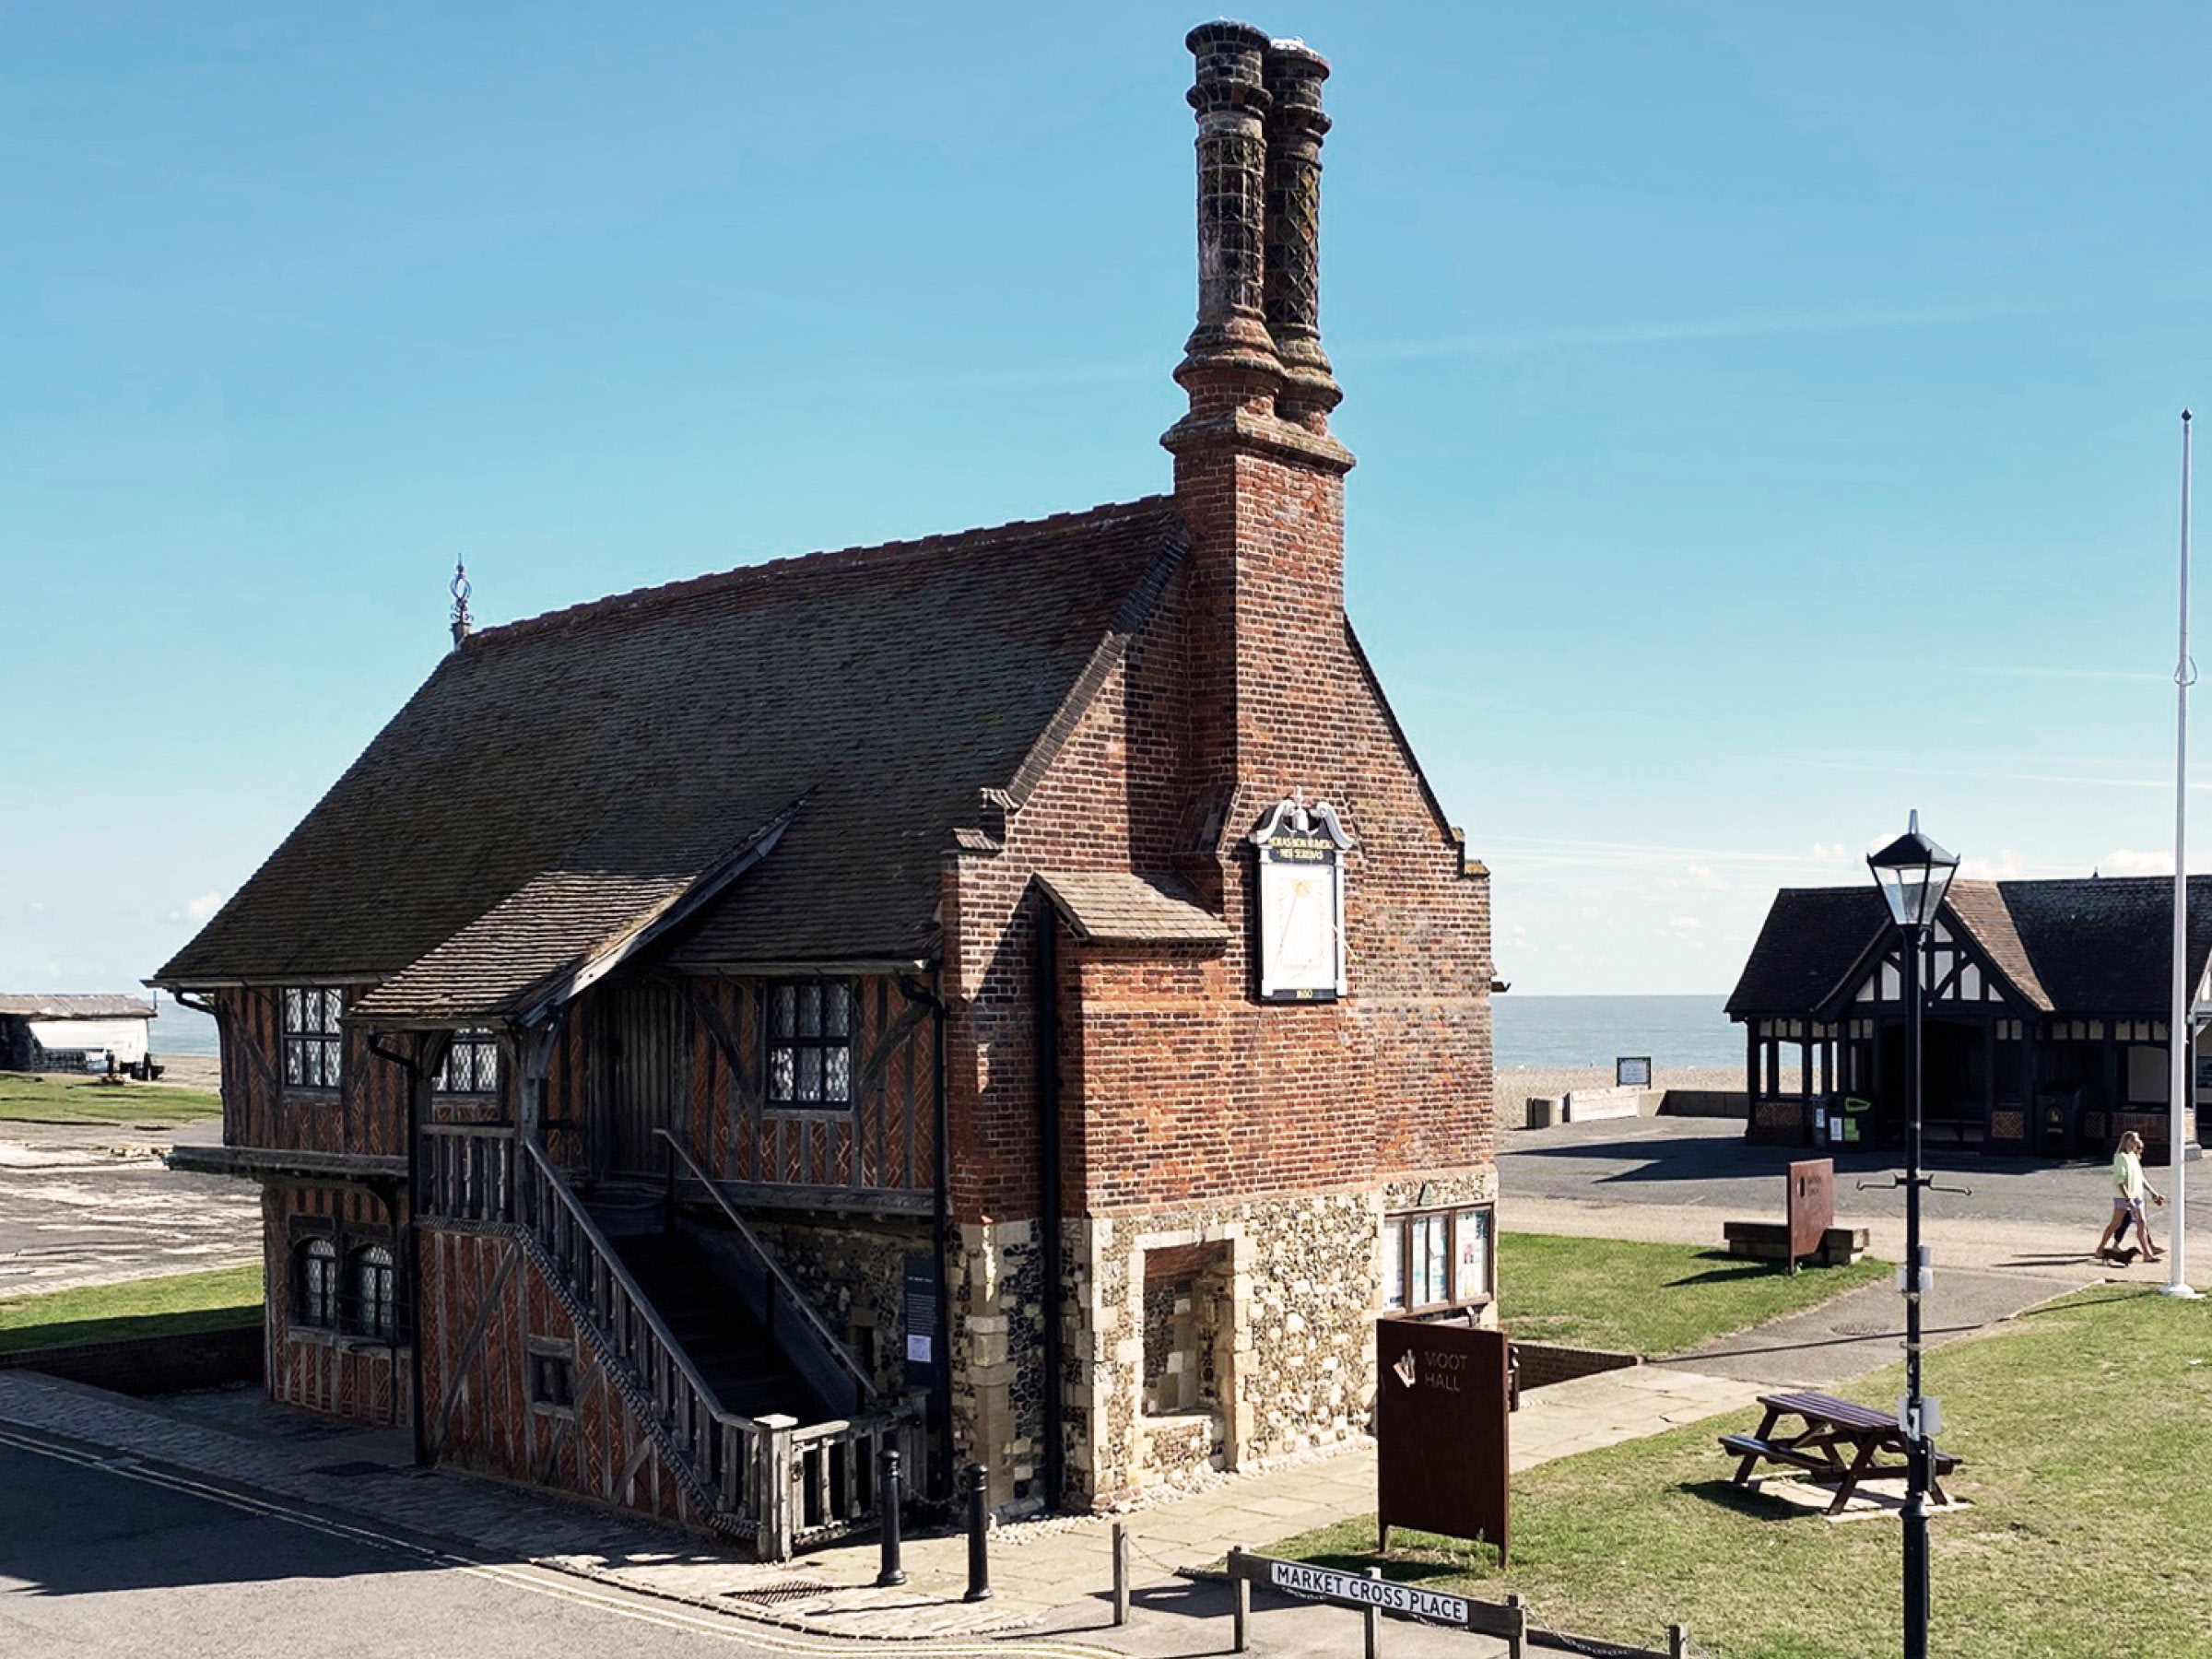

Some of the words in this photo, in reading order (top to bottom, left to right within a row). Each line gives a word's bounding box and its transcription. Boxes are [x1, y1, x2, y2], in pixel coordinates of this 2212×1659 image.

[1424, 1350, 1468, 1371] MOOT
[1424, 1371, 1461, 1393] HALL
[1277, 1565, 1344, 1594] MARKET
[1348, 1581, 1404, 1607] CROSS
[1408, 1592, 1463, 1619] PLACE
